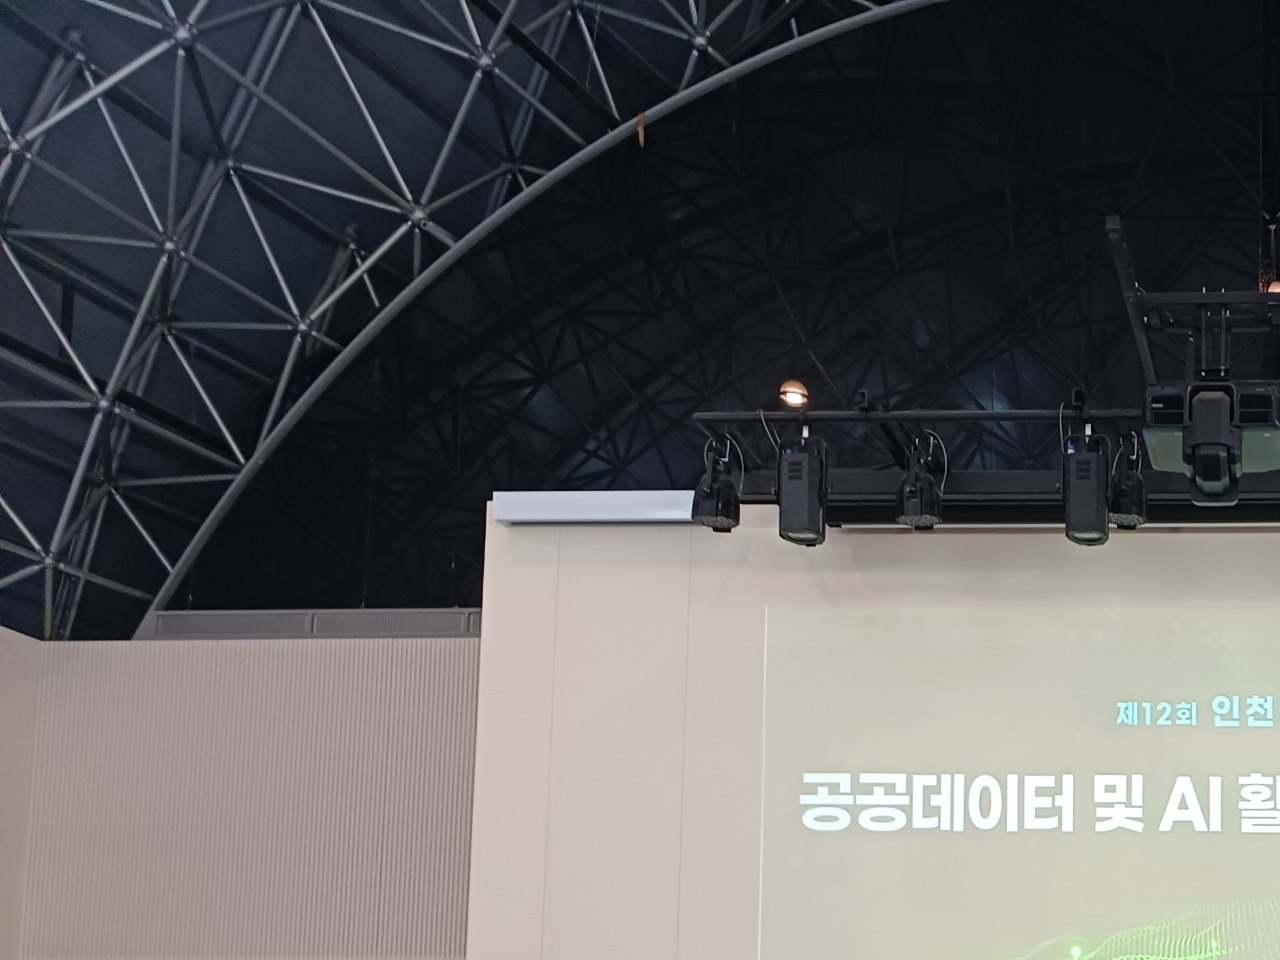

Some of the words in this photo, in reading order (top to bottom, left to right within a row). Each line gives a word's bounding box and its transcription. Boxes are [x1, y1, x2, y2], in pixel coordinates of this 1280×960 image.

[1116, 701, 1197, 726] 제12회
[800, 772, 1074, 832] 공공데이터
[1093, 773, 1145, 833] 및
[1158, 775, 1222, 832] AI
